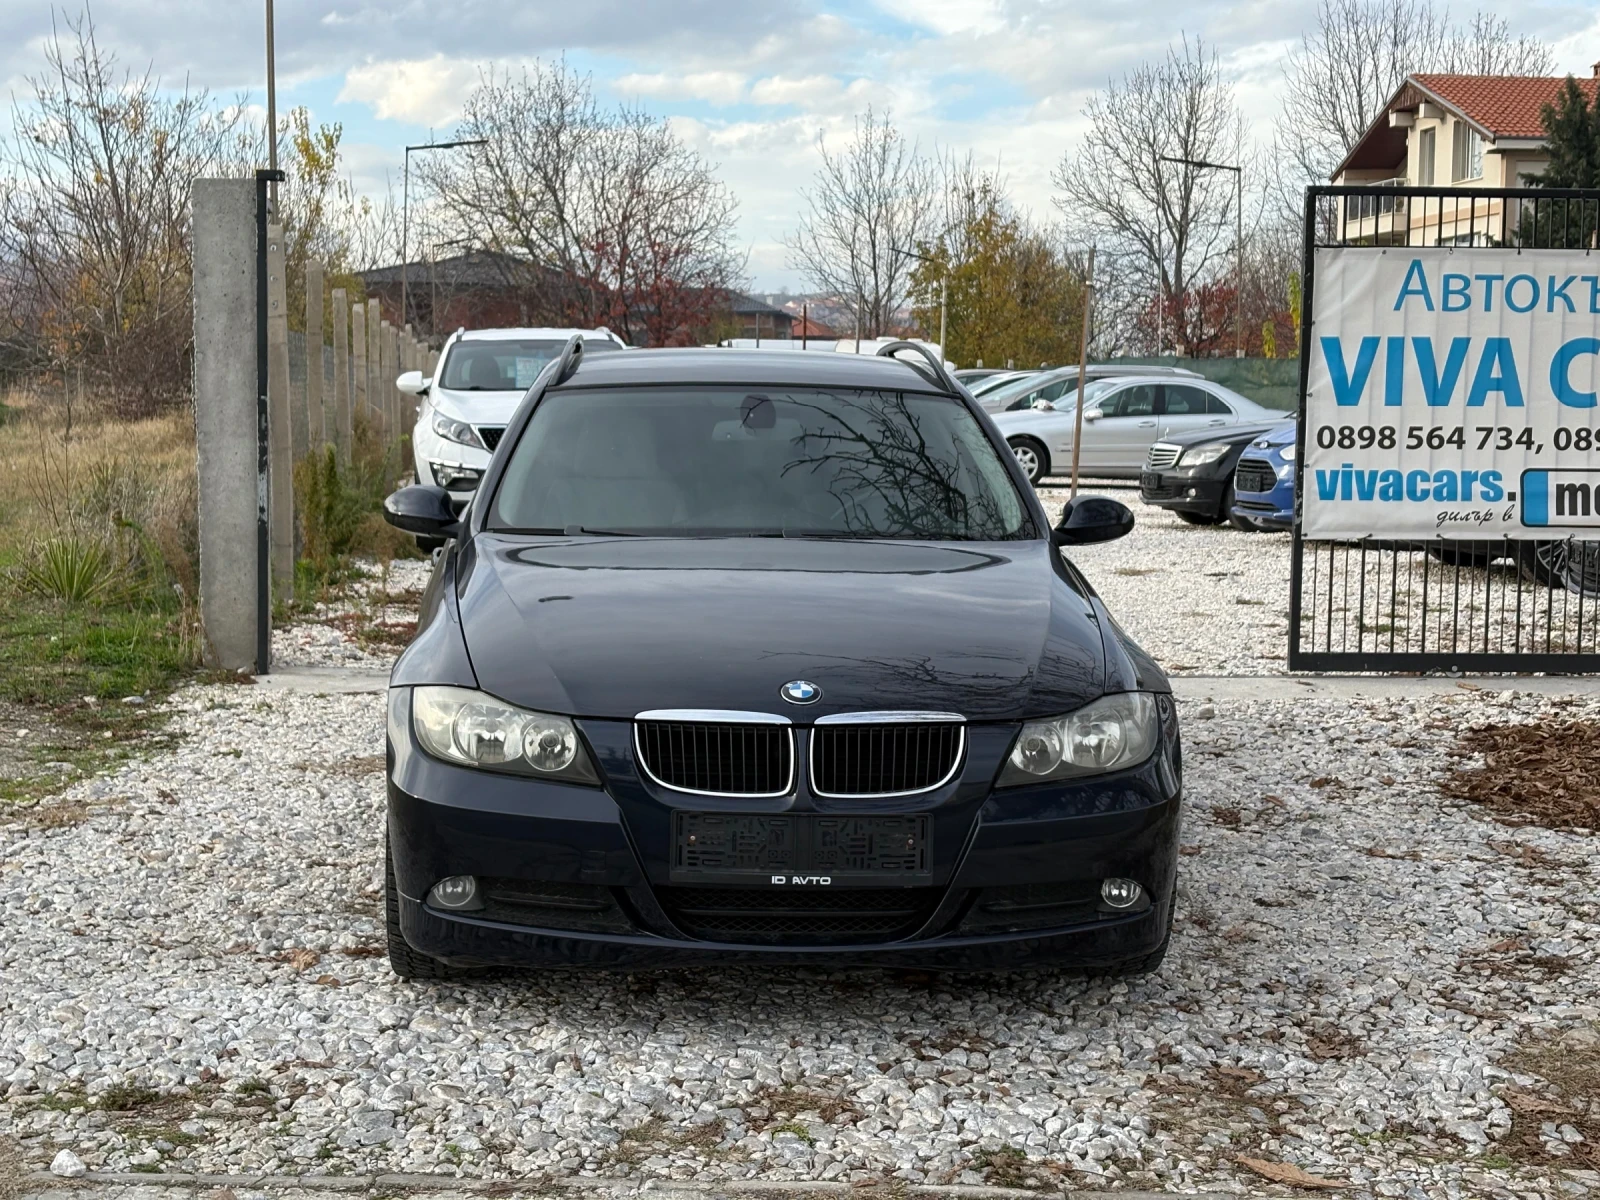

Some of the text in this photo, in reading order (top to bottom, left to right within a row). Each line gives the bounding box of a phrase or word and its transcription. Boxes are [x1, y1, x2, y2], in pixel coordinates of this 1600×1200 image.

[1319, 335, 1525, 408] VIVA
[1316, 425, 1397, 450] 0898
[1405, 426, 1466, 451] 564
[1475, 426, 1544, 455] 734,
[1315, 463, 1517, 502] vivacars.
[771, 875, 832, 886] ID AVTO
